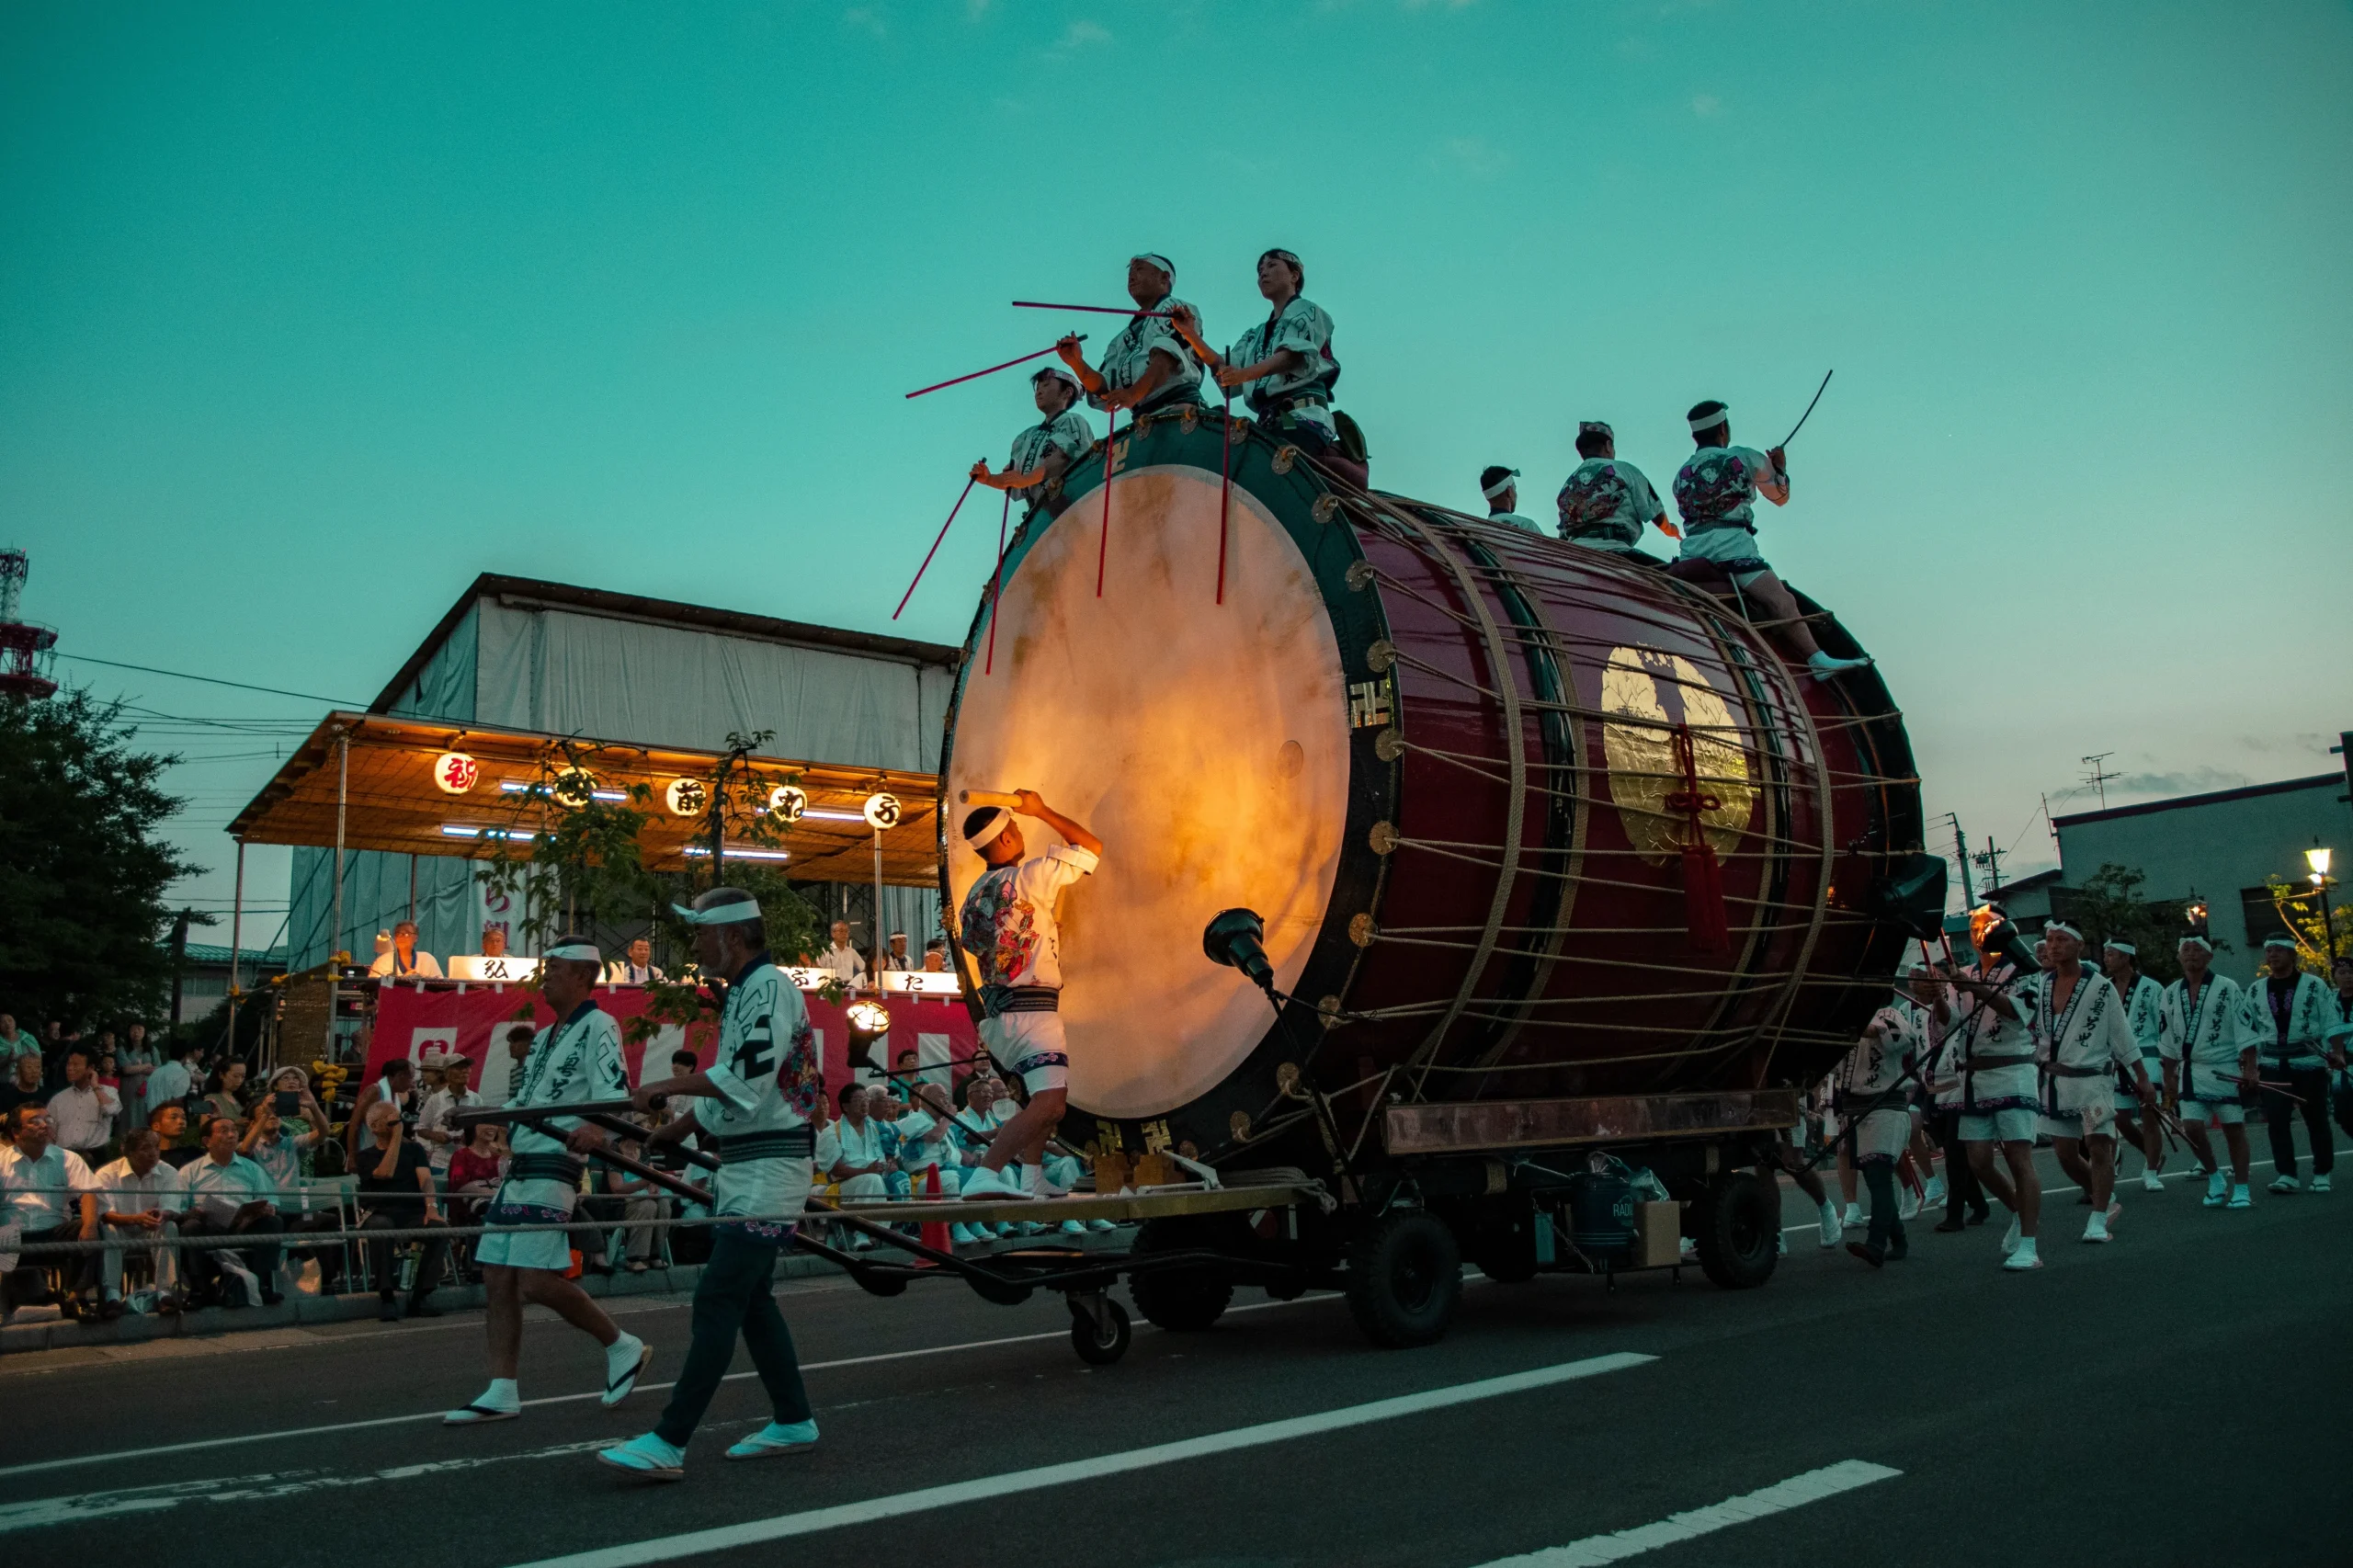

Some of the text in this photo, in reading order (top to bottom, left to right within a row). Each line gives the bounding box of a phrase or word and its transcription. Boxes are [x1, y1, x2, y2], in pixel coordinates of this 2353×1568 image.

[444, 756, 478, 790] 祝
[675, 781, 709, 812] 前
[778, 790, 807, 818] ね
[483, 960, 509, 979] 弘
[792, 970, 811, 986] ぷ
[904, 974, 925, 990] た
